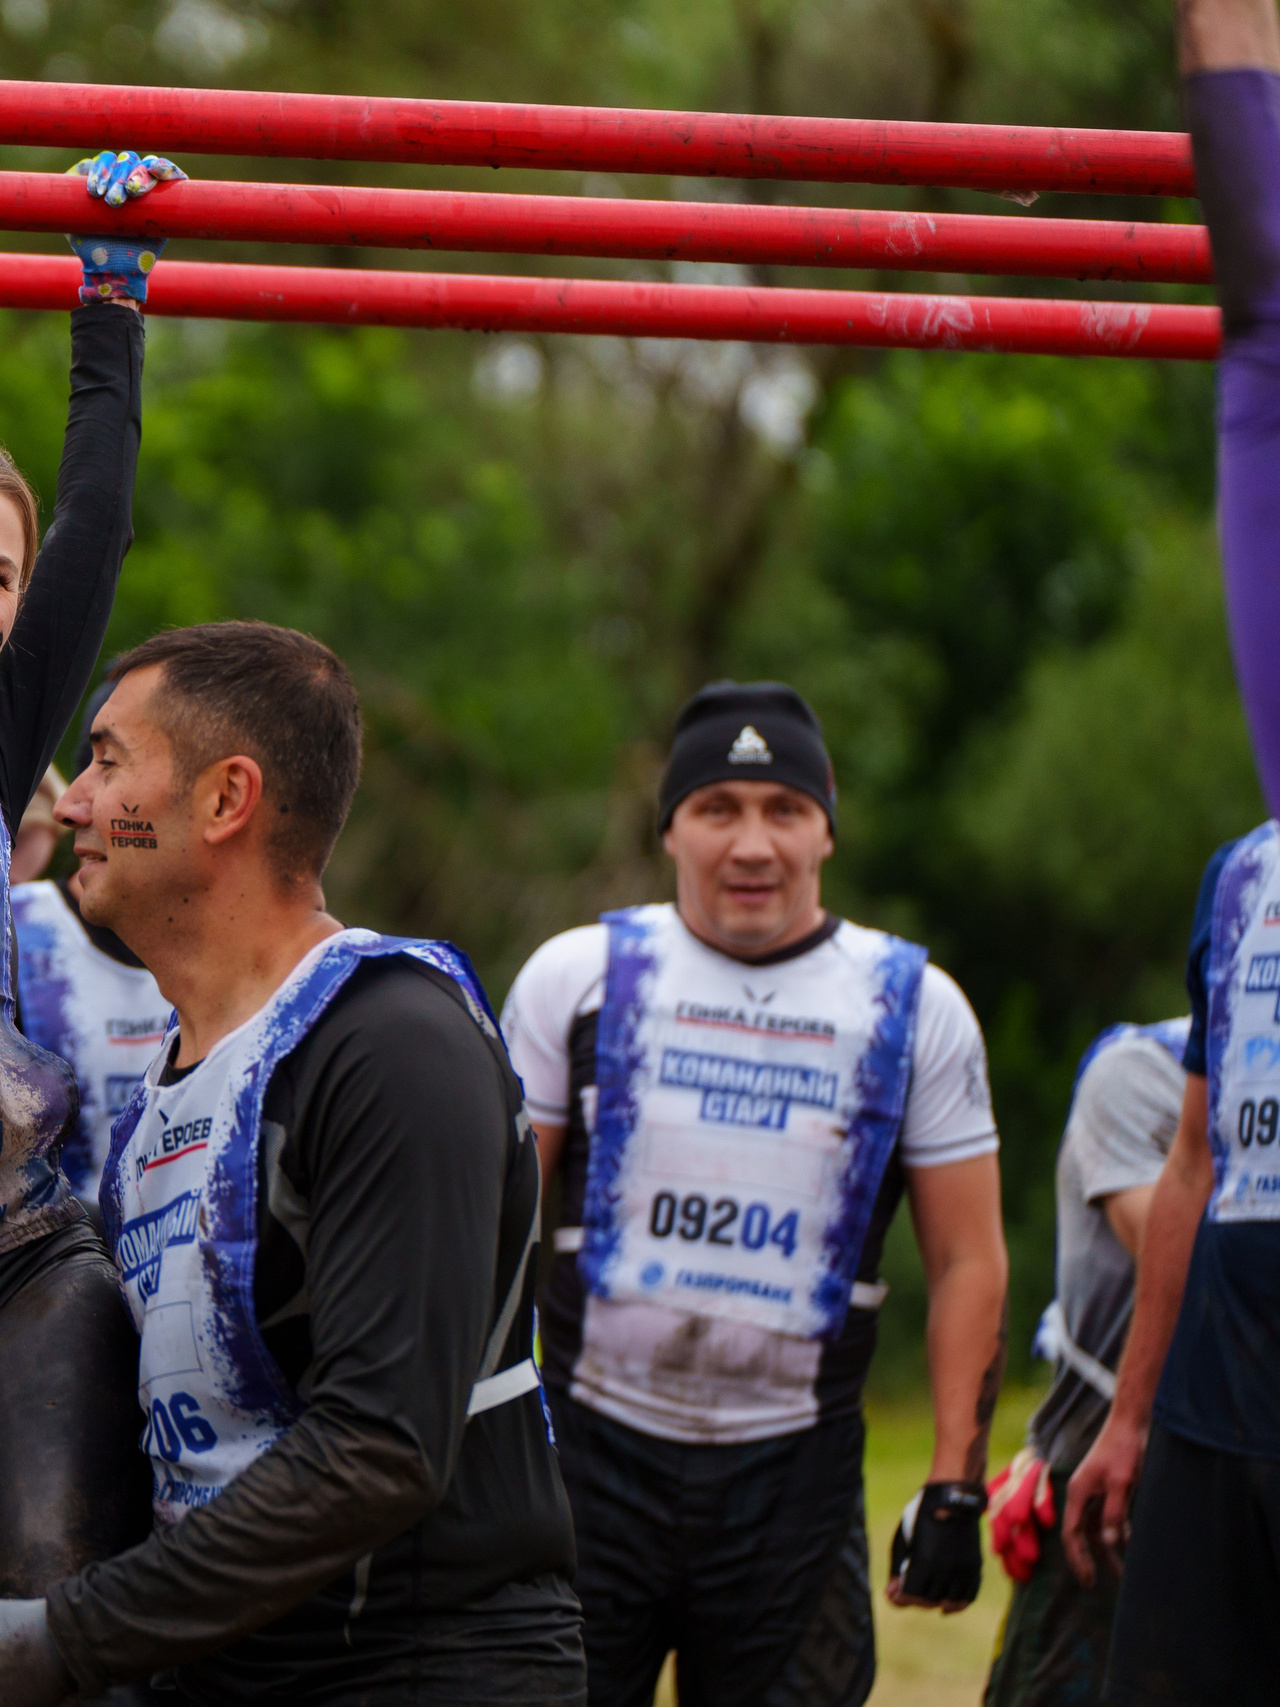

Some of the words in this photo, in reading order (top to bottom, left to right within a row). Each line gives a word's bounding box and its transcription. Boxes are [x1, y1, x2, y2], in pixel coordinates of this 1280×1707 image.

[110, 819, 155, 832] ГОНКА
[110, 836, 158, 849] ГЕРОЕВ
[663, 1052, 835, 1106] КОМАНДНЫЙ
[703, 1091, 782, 1127] СТАРТ
[1239, 1098, 1280, 1148] 09
[649, 1189, 800, 1258] 09204
